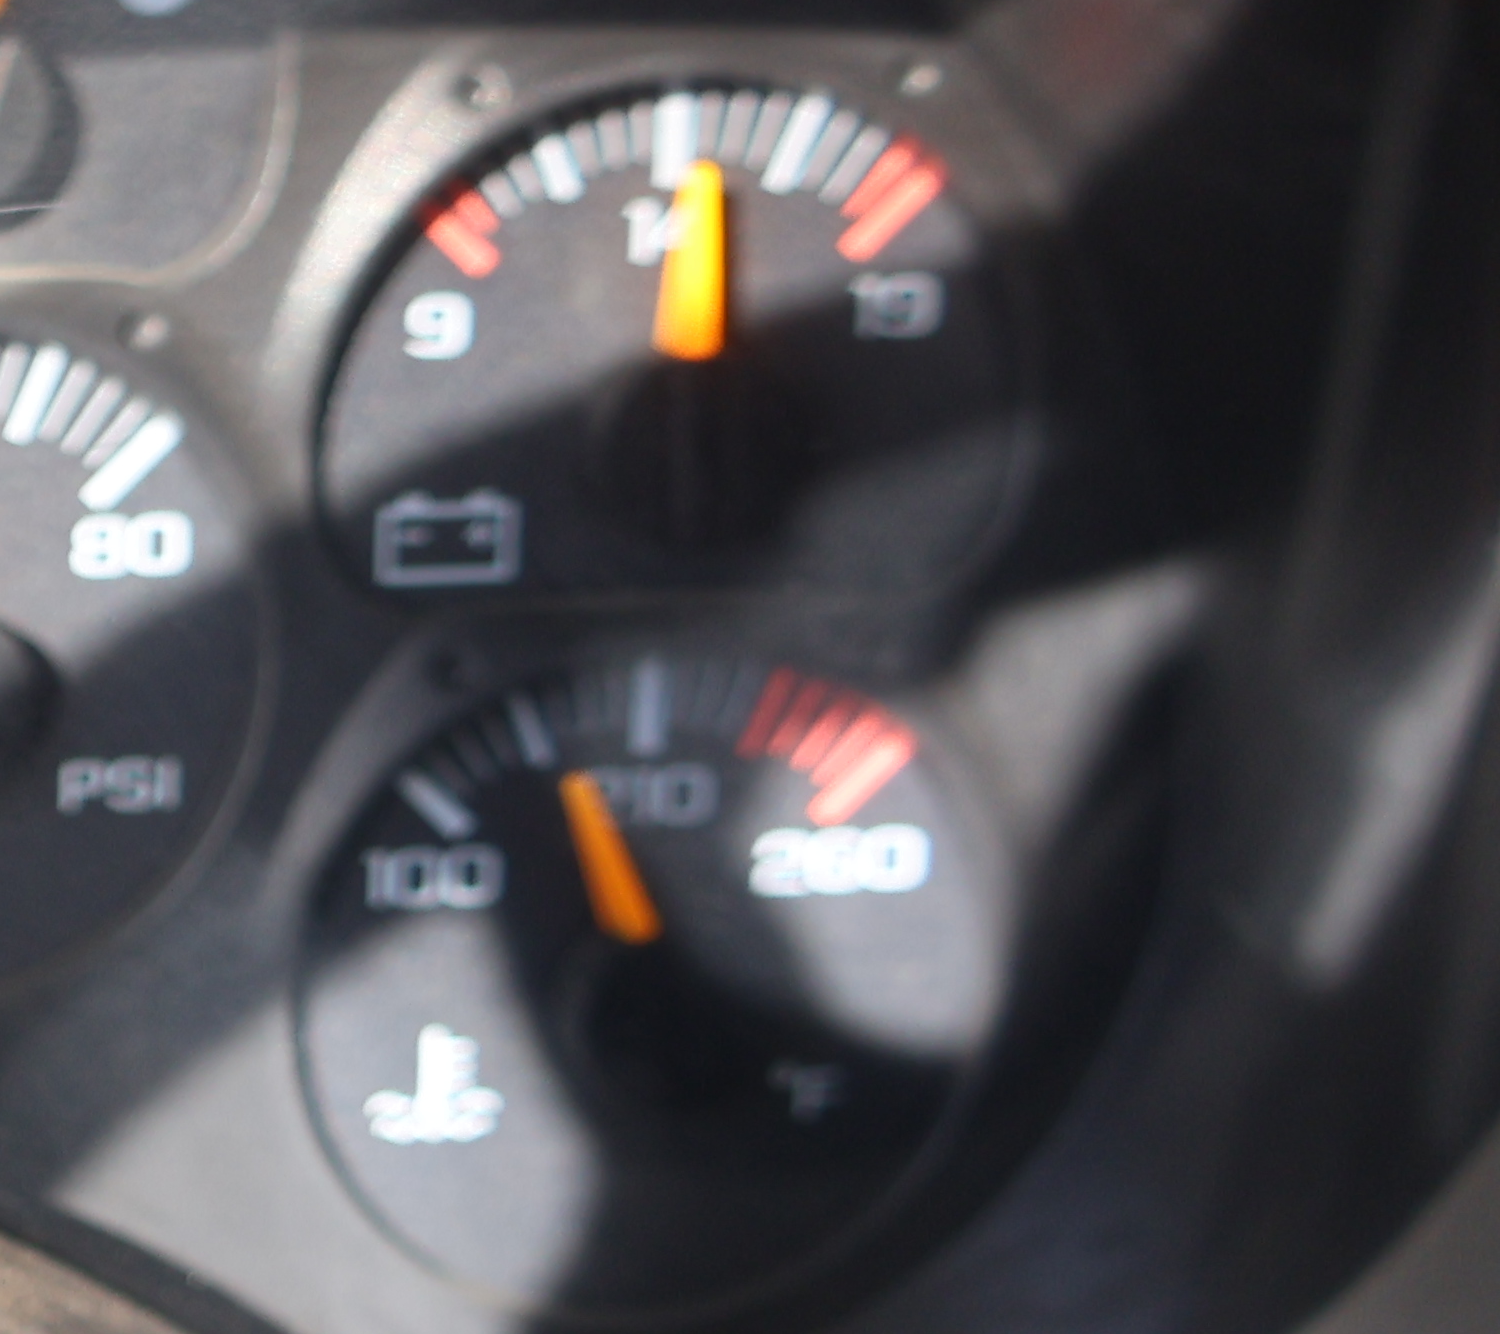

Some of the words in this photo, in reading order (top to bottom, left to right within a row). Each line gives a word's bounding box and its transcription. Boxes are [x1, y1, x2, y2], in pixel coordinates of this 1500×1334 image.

[405, 292, 477, 361] 9
[68, 511, 194, 579] 80
[56, 755, 184, 816] PSI
[363, 845, 504, 909] 100
[749, 822, 934, 898] 260
